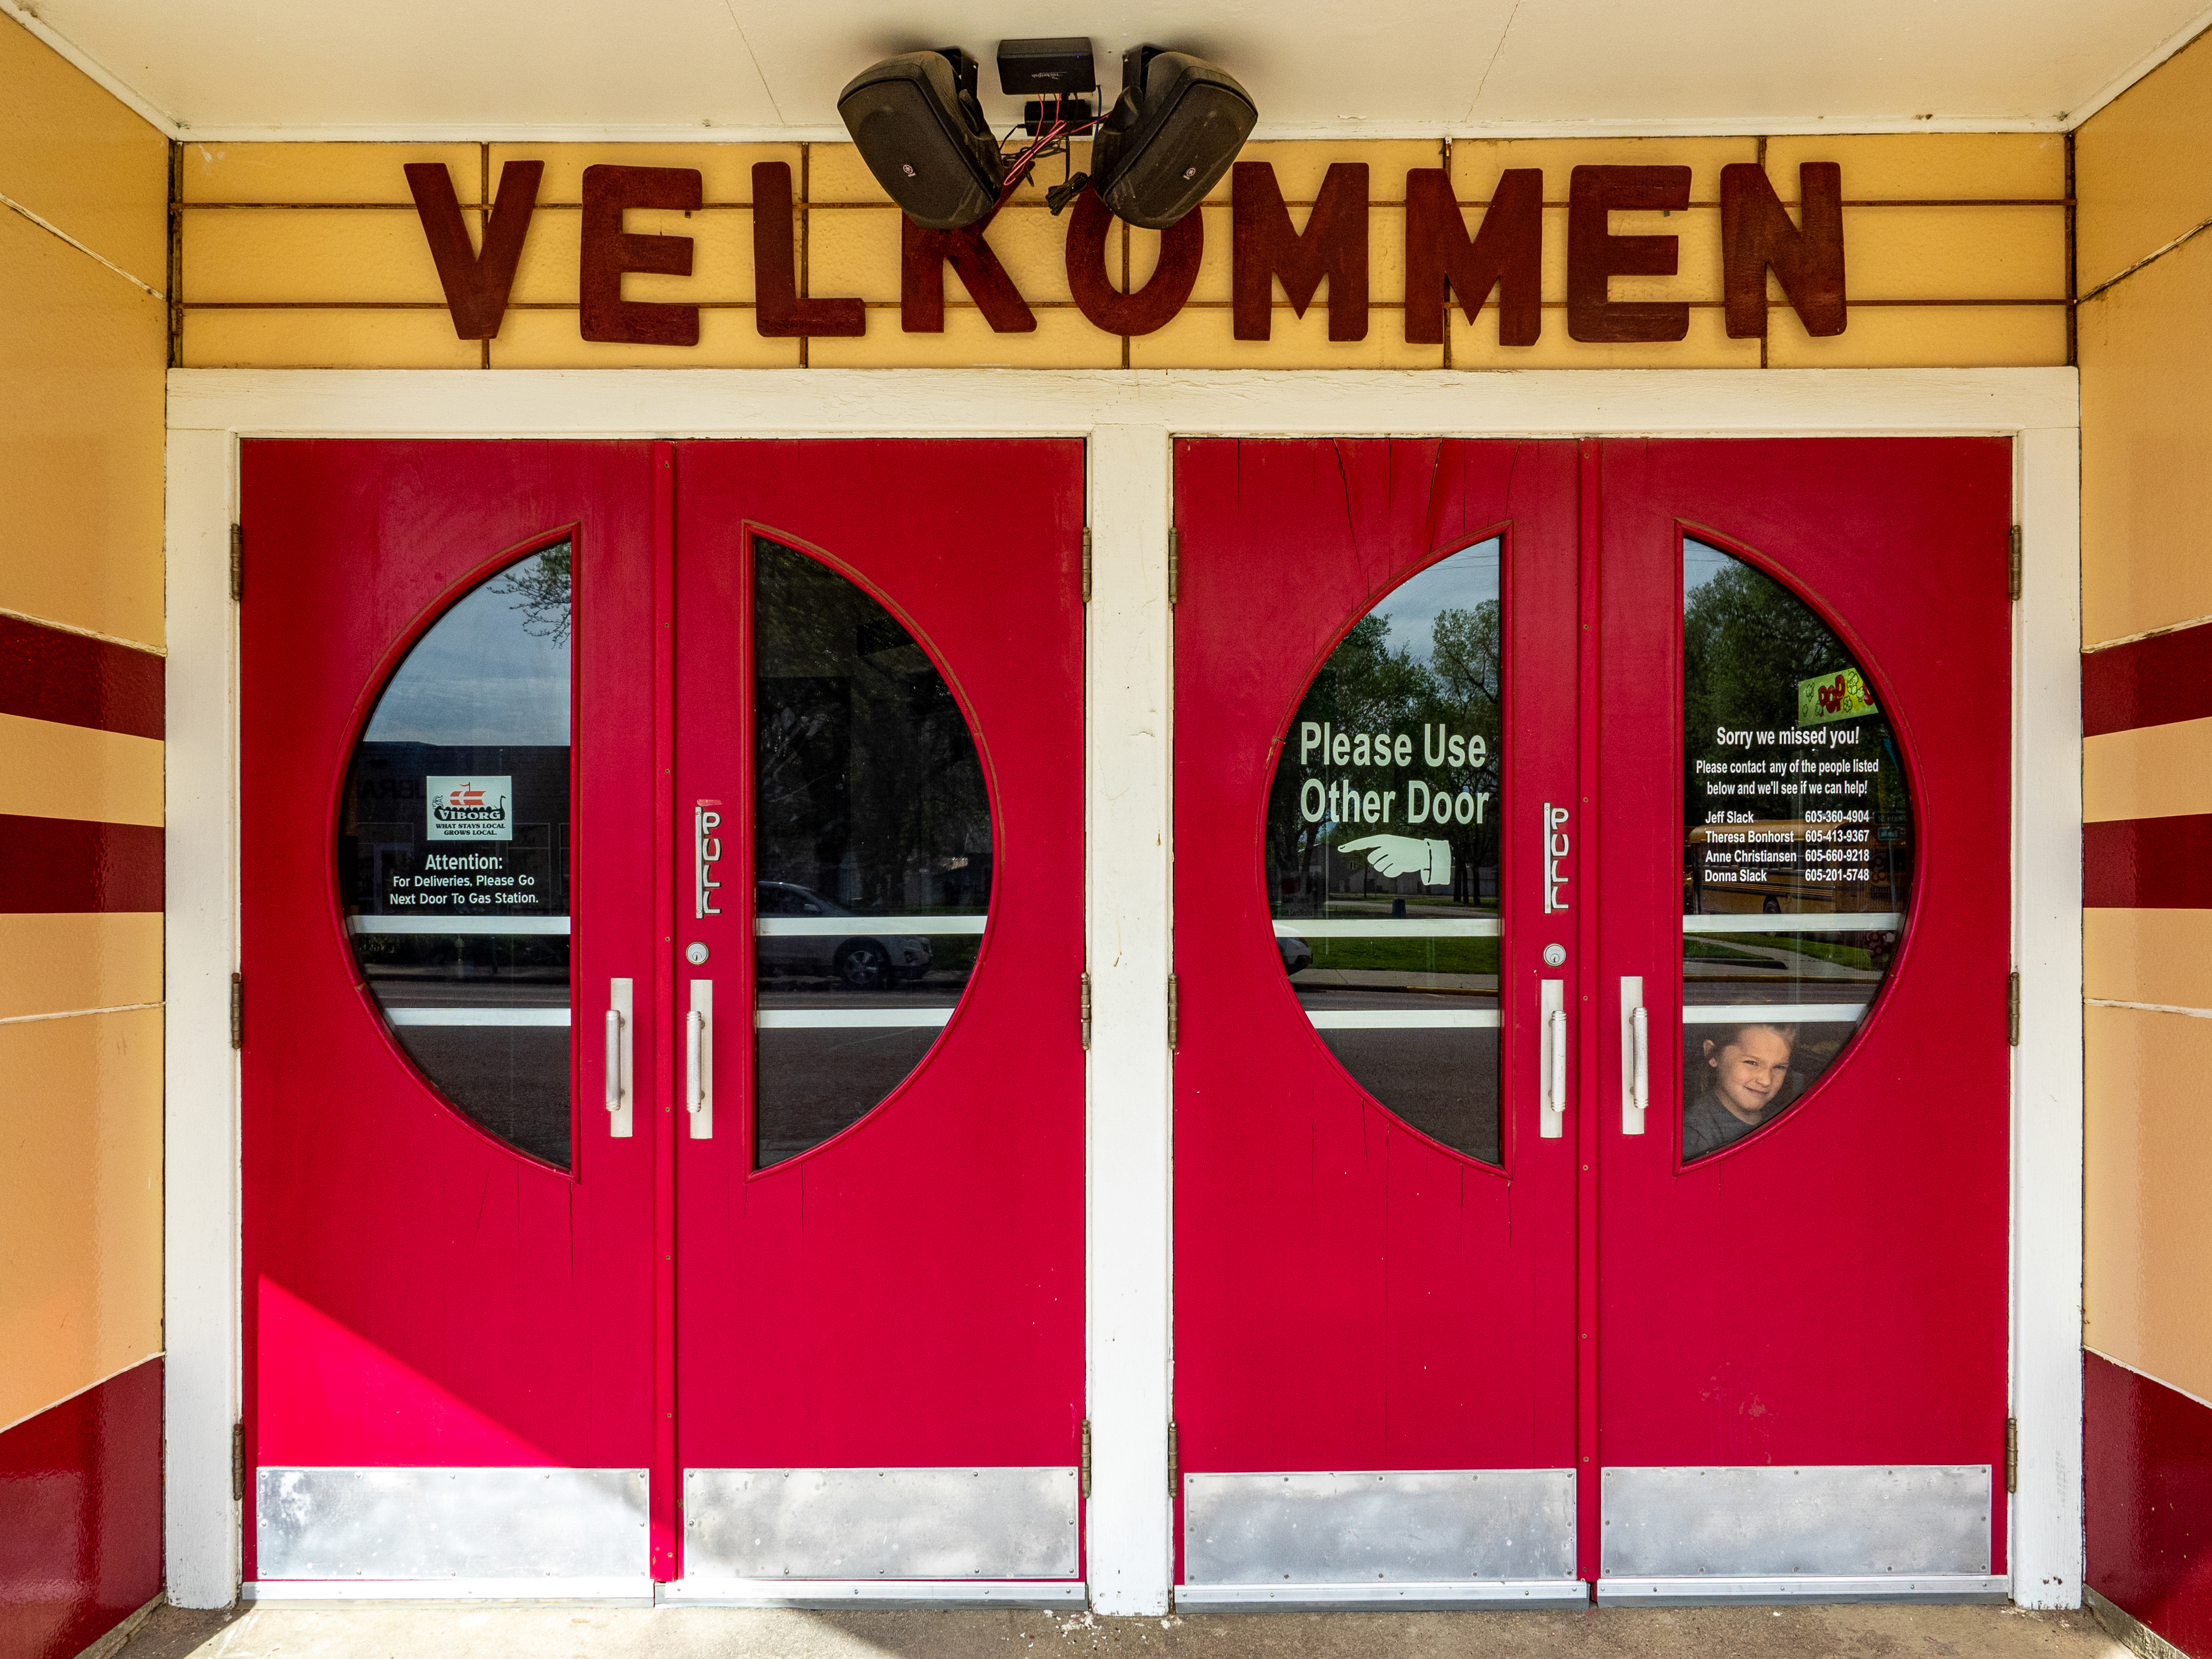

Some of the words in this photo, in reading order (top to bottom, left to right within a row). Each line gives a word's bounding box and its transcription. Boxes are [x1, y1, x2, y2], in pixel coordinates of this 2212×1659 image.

[403, 159, 1847, 347] VELKOMMEN
[1301, 722, 1412, 766] Please
[1425, 724, 1486, 767] Use
[1717, 727, 1753, 749] Sorry
[1756, 731, 1775, 745] we
[1779, 726, 1826, 744] missed
[1830, 726, 1859, 749] you!
[1696, 760, 1728, 773] Please
[1730, 760, 1766, 773] contact
[1770, 763, 1787, 777] any
[1789, 759, 1800, 773] of
[1801, 759, 1816, 773] the
[1819, 759, 1851, 776] people
[1853, 759, 1878, 772] listed
[1707, 781, 1735, 795] below
[1737, 781, 1755, 794] and
[1757, 781, 1778, 794] we'll
[1781, 784, 1798, 794] see
[1800, 780, 1807, 794] if
[1809, 784, 1822, 794] we
[1825, 783, 1841, 794] can
[1844, 780, 1867, 797] help!
[1301, 779, 1396, 823] Other
[1408, 781, 1489, 824] Door
[438, 809, 501, 820] VIBORG
[1705, 811, 1724, 824] Jeff
[1727, 811, 1754, 823] Slack
[1805, 810, 1870, 823] 605-360-4904
[1705, 830, 1745, 843] Theresa
[1748, 830, 1794, 842] Bonhorst
[1805, 830, 1870, 842] 605-413-9367
[425, 853, 502, 870] Attention:
[702, 812, 721, 914] PULL
[1551, 807, 1569, 909] PULL
[1705, 850, 1731, 862] Anne
[1734, 849, 1796, 862] Christiansen
[1805, 849, 1870, 862] 605-660-9218
[394, 876, 410, 887] For
[415, 875, 472, 887] Deliveries,
[477, 875, 514, 886] Please
[518, 874, 535, 885] Go
[1705, 870, 1737, 882] Donna
[1740, 869, 1767, 882] Slack
[1805, 869, 1870, 881] 605-201-5748
[390, 894, 416, 904] Next
[420, 893, 447, 904] Door
[452, 893, 465, 904] To
[469, 893, 491, 904] Gas
[495, 892, 539, 903] Station.
